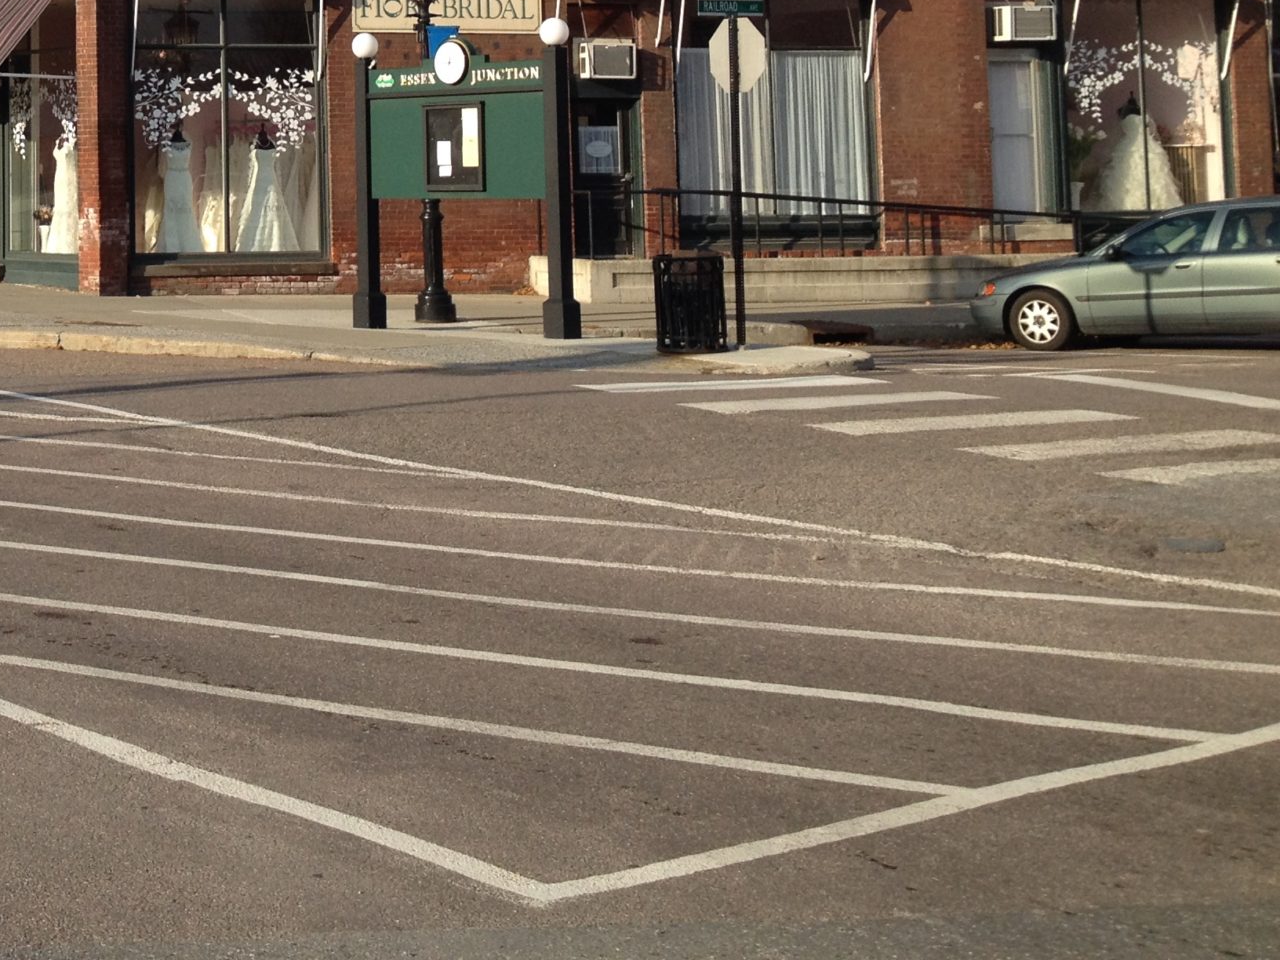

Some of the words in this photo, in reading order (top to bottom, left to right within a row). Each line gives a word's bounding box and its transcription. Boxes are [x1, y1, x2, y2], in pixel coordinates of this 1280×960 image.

[703, 1, 738, 12] RAILROAD
[400, 73, 437, 86] ESSEX
[471, 66, 540, 86] JUNCTION
